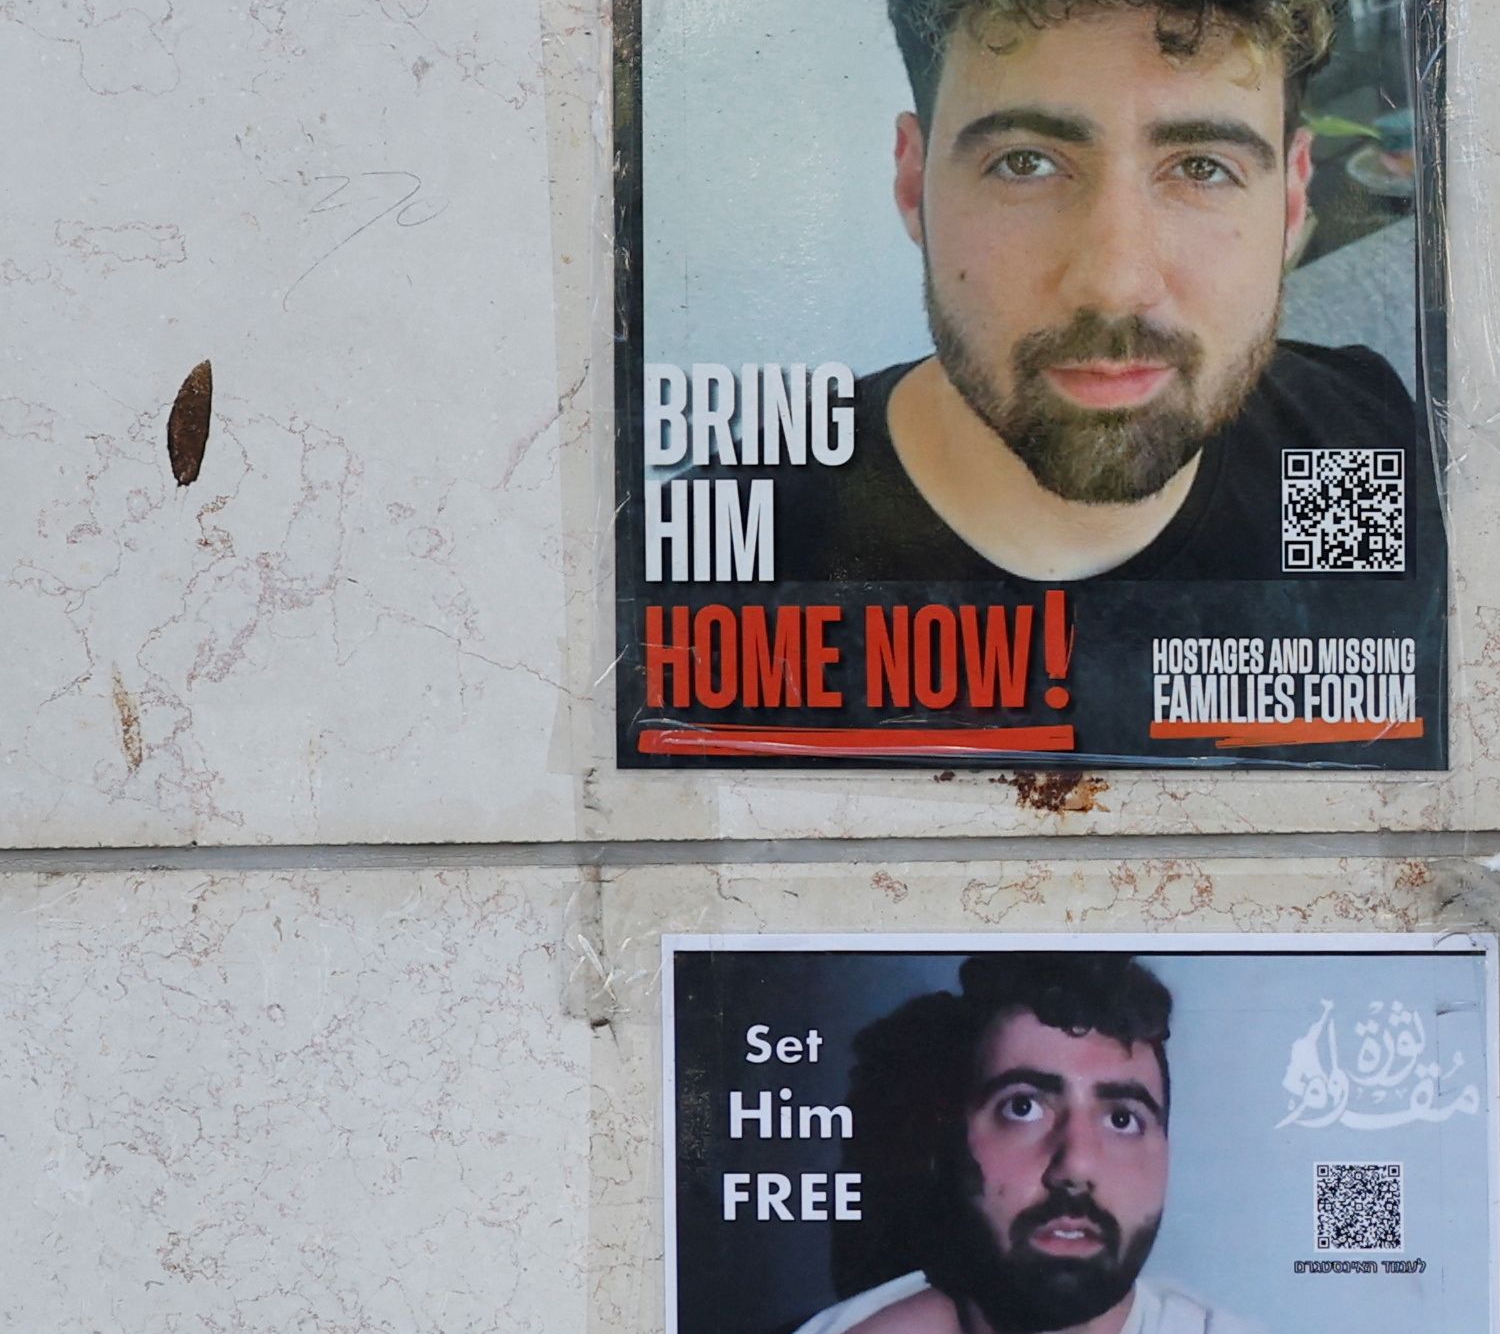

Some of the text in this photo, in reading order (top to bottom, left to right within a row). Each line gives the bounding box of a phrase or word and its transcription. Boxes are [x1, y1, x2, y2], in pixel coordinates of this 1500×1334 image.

[644, 361, 855, 467] BRING
[644, 478, 774, 582] HIM
[646, 589, 1070, 710] HOME NOW!
[1153, 638, 1416, 674] HOSTAGES AND MISSING
[1154, 674, 1416, 724] FAMILIES FORUM
[745, 1025, 822, 1065] Set
[728, 1089, 854, 1140] Him
[721, 1173, 862, 1222] FREE
[1293, 1257, 1427, 1274] לעמוד האינסטגרם
